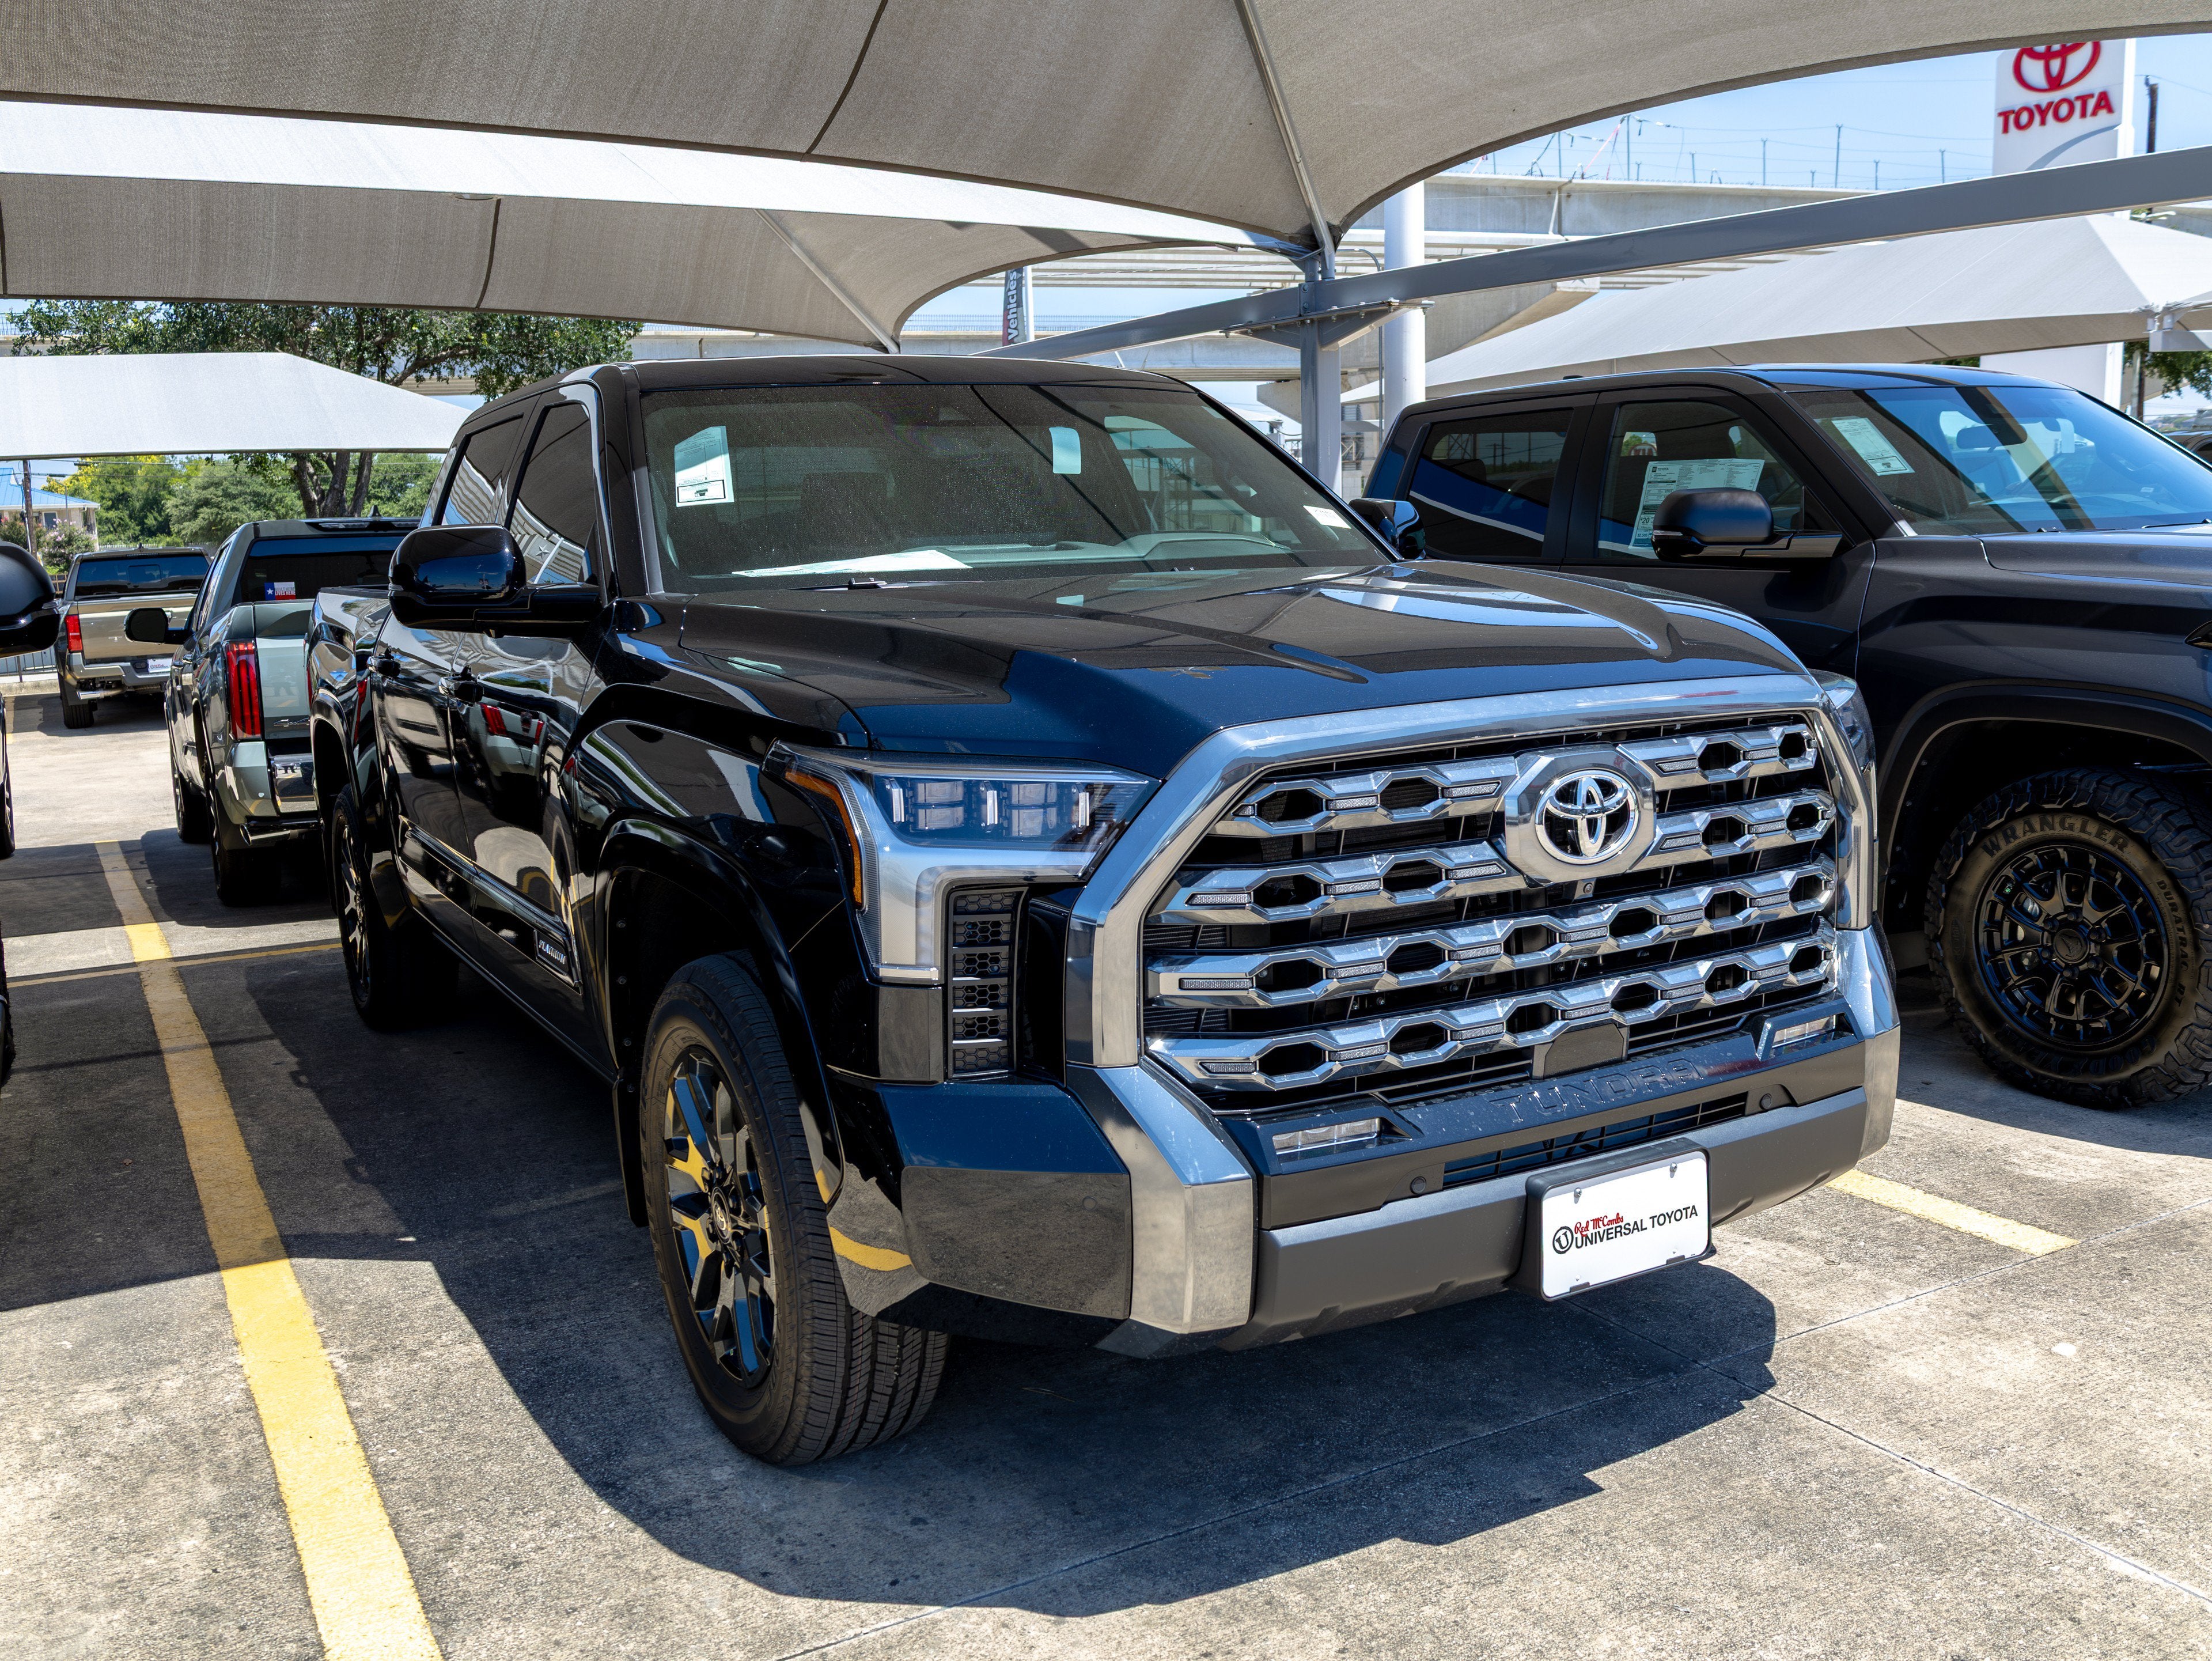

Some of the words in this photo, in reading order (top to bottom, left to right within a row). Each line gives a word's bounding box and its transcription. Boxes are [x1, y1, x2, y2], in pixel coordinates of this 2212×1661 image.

[1997, 91, 2115, 135] TOYOTA
[1007, 271, 1018, 340] Vehicles
[1980, 814, 2131, 858] WRANGLER
[2156, 880, 2188, 971] DURATRAC
[539, 939, 566, 964] PLATINUM
[1488, 1058, 1703, 1123] TUNDRA
[1574, 1220, 1589, 1237] Red
[1590, 1212, 1624, 1230] McCombs
[1575, 1219, 1647, 1249] UNIVERSAL
[1649, 1205, 1698, 1228] TOYOTA
